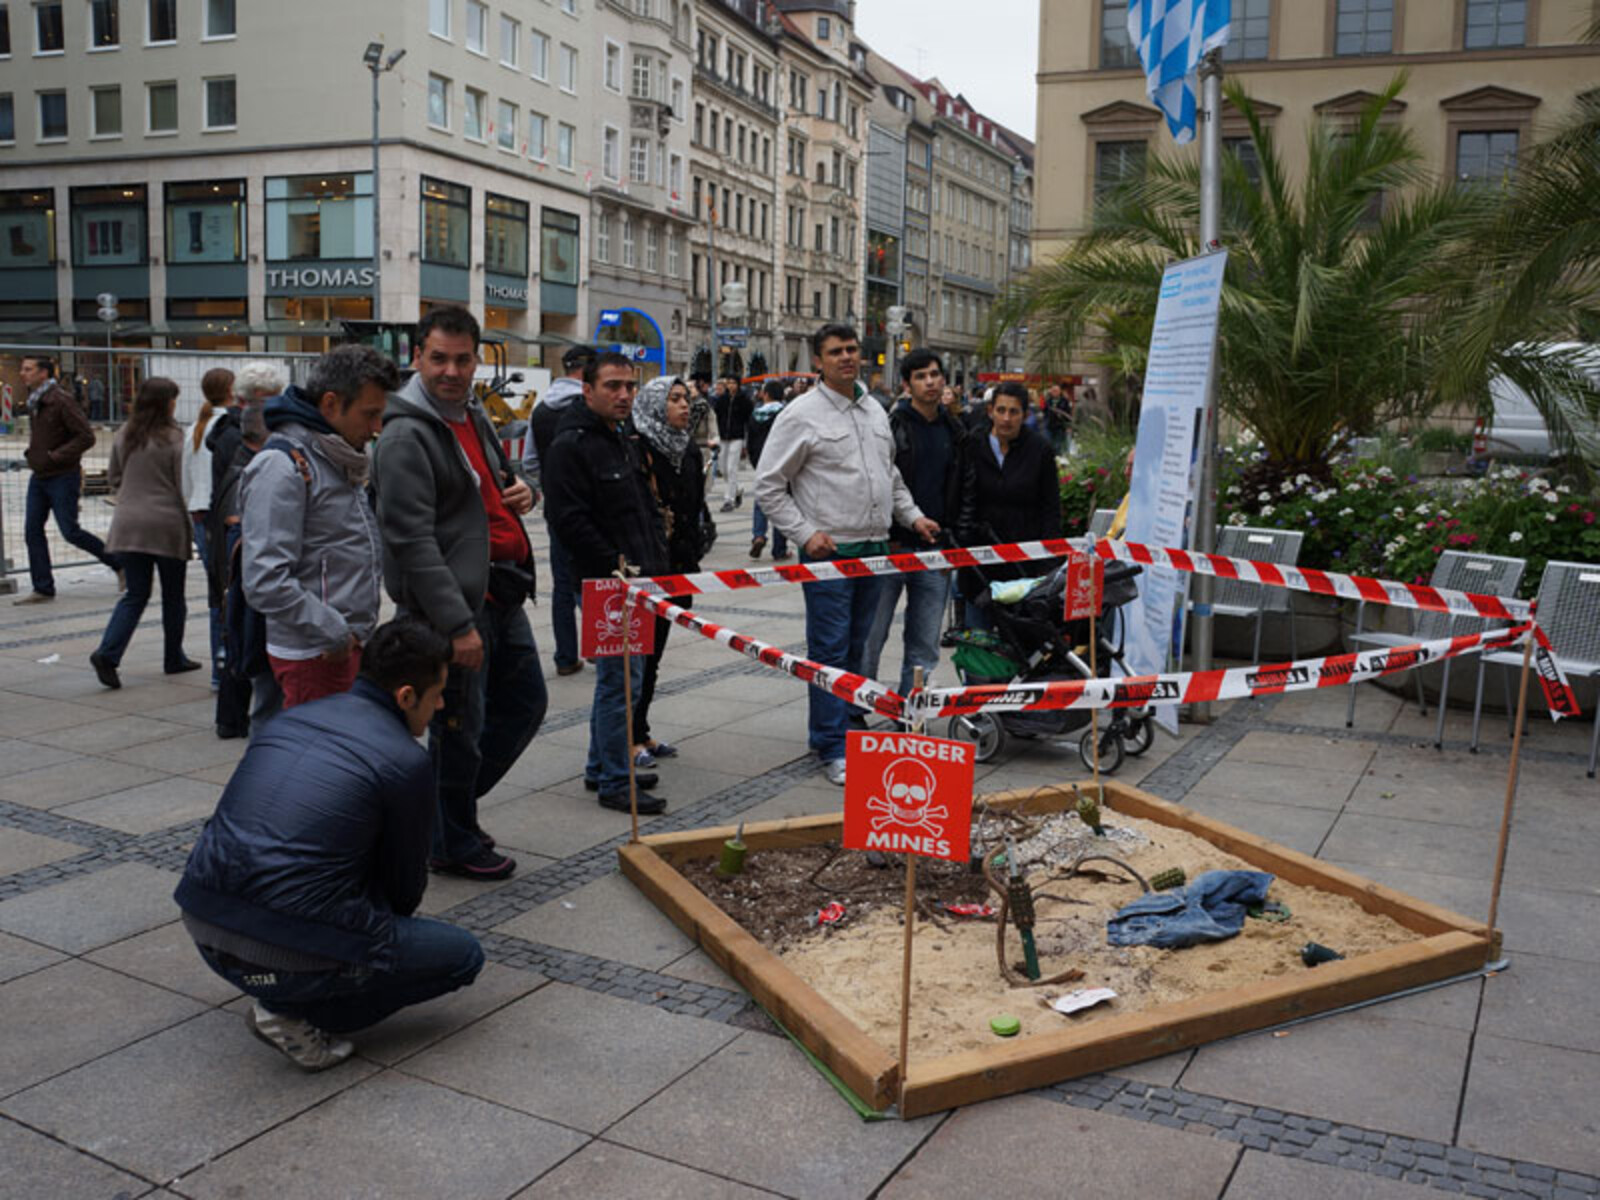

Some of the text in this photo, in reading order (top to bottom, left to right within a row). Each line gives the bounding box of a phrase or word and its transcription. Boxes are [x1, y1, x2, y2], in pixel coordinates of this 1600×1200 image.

[268, 267, 374, 288] THOMAS
[595, 580, 621, 591] DAN
[861, 735, 966, 763] DANGER
[865, 831, 951, 856] MINES
